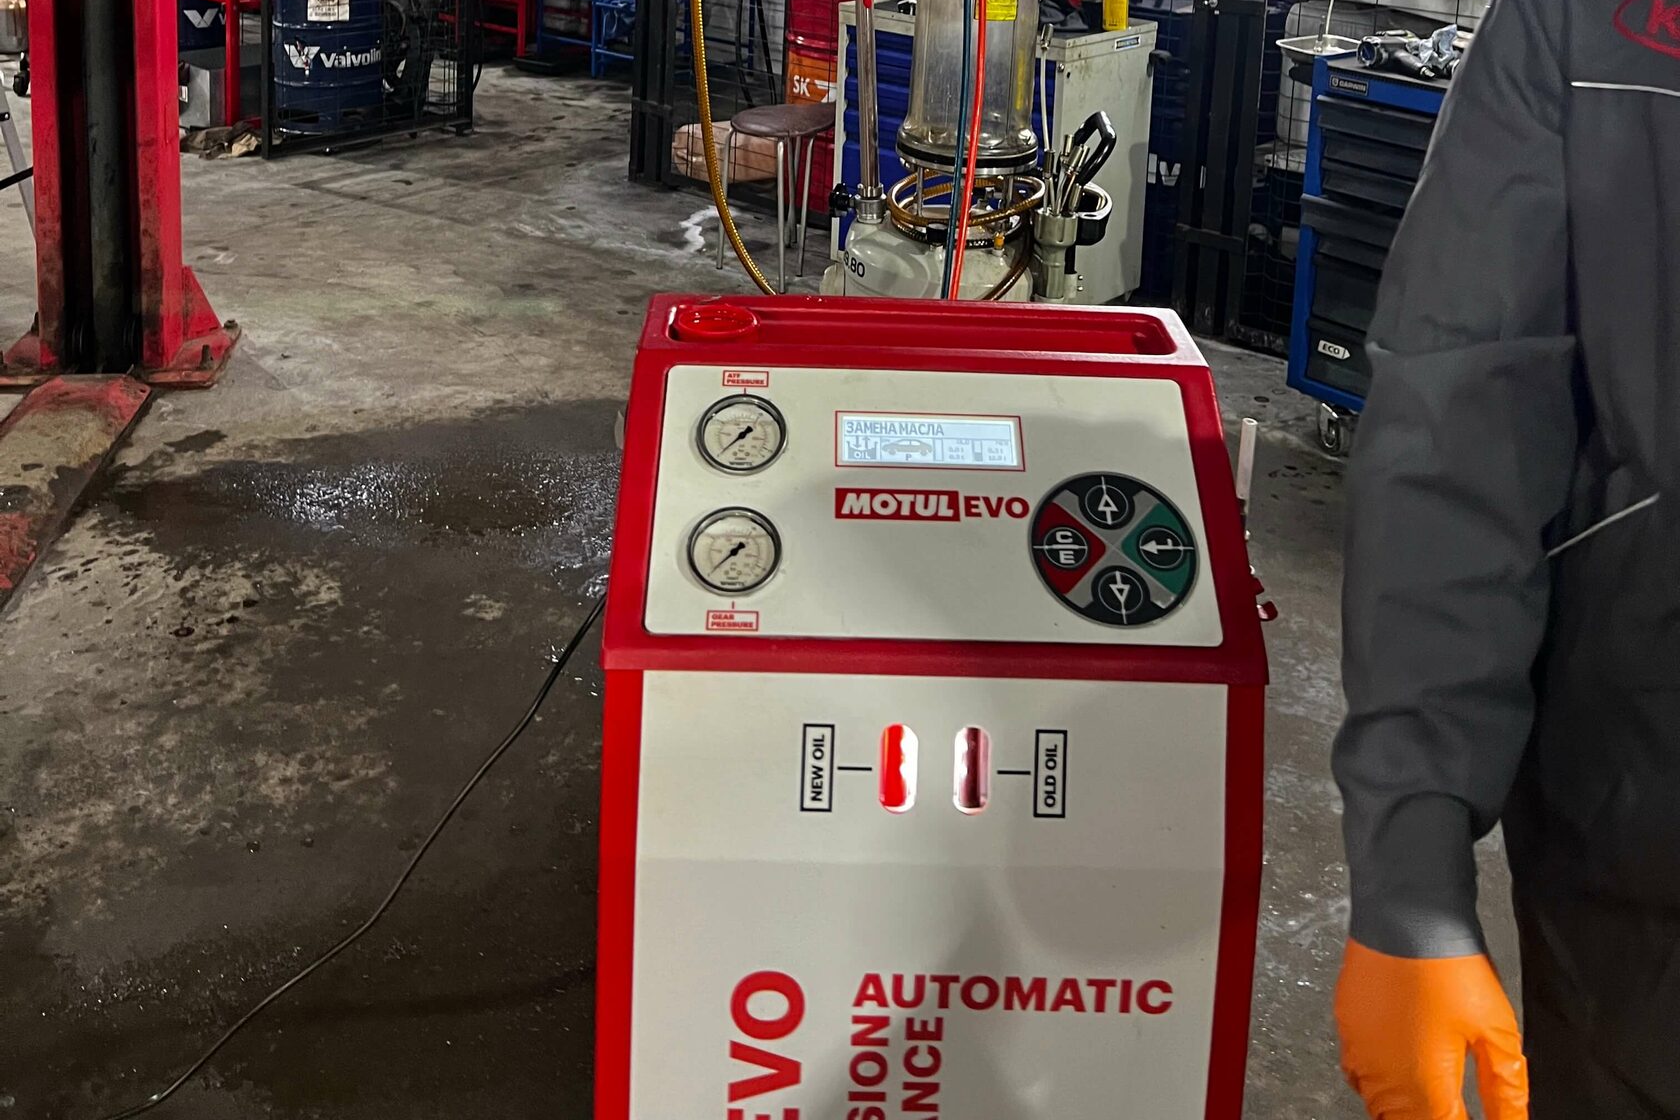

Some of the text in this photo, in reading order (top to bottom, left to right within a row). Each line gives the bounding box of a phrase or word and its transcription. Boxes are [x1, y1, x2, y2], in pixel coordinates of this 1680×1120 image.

[1647, 0, 1680, 39] K
[320, 46, 382, 68] Valvolin
[1322, 343, 1340, 355] ECO
[846, 421, 945, 436] ЗАМЕНА МАСЛА
[854, 452, 871, 460] OIL
[841, 492, 1030, 519] MOTUL EVO
[811, 734, 826, 802] NEW OIL
[1043, 743, 1058, 808] OLD OIL
[852, 973, 1174, 1015] AUTOMATIC
[727, 970, 806, 1120] VO
[902, 1016, 944, 1120] NCE
